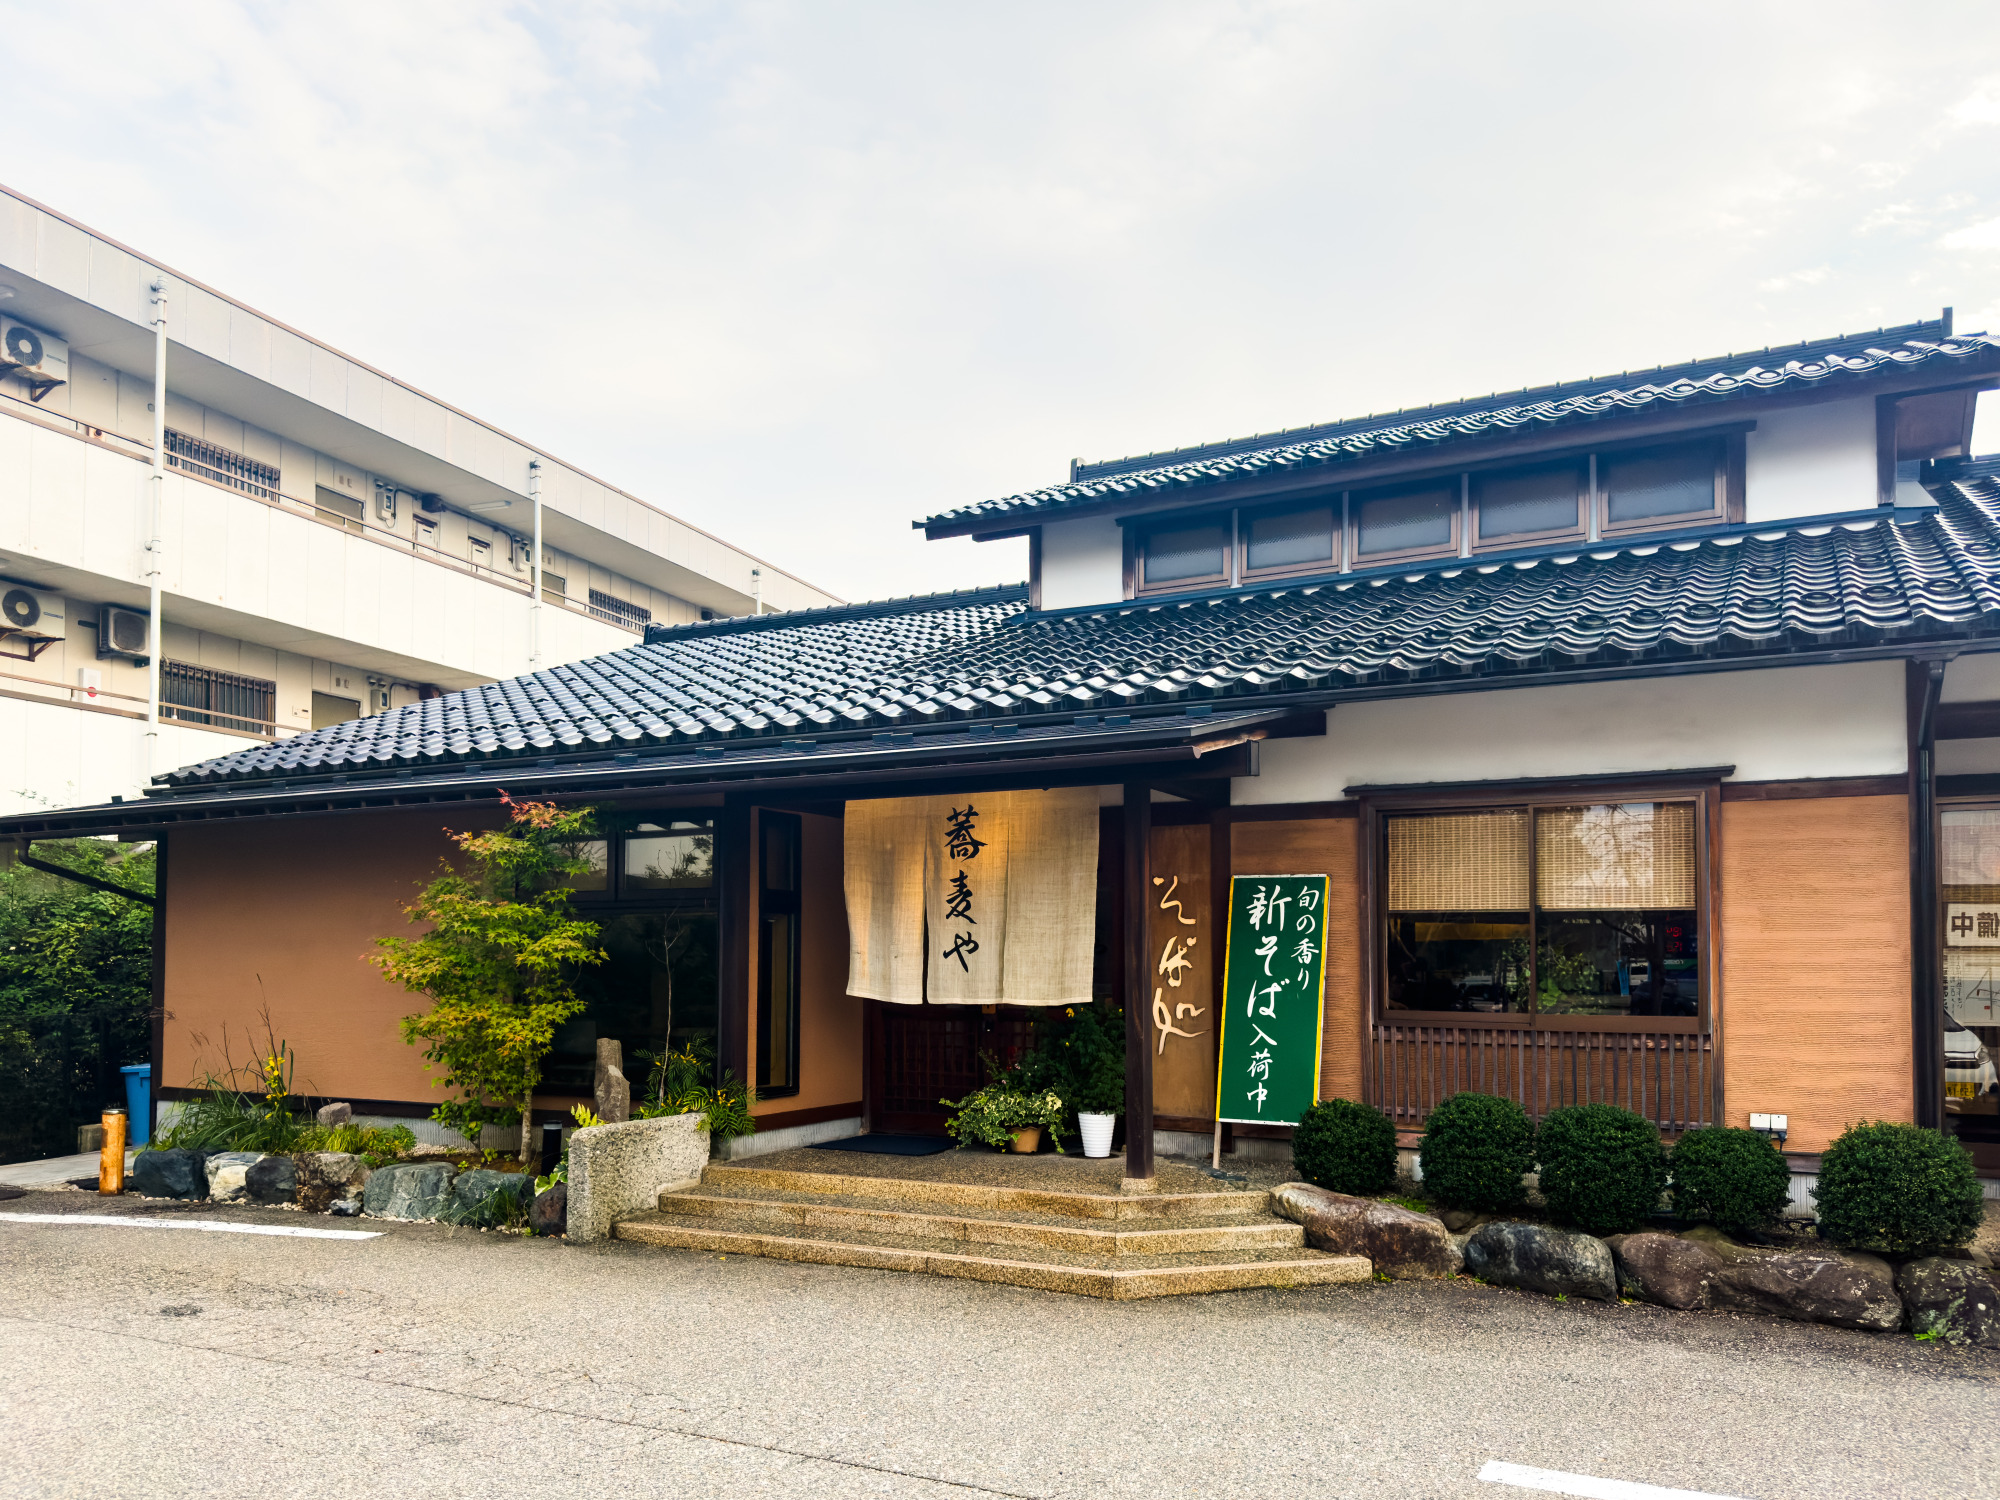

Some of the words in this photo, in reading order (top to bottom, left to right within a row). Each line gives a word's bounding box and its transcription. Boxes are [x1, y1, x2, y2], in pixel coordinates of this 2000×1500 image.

[943, 804, 988, 973] 蕎麦や
[1152, 875, 1211, 1055] そば処
[1290, 885, 1320, 991] 旬の香り
[1246, 885, 1292, 1114] 新そば入荷中
